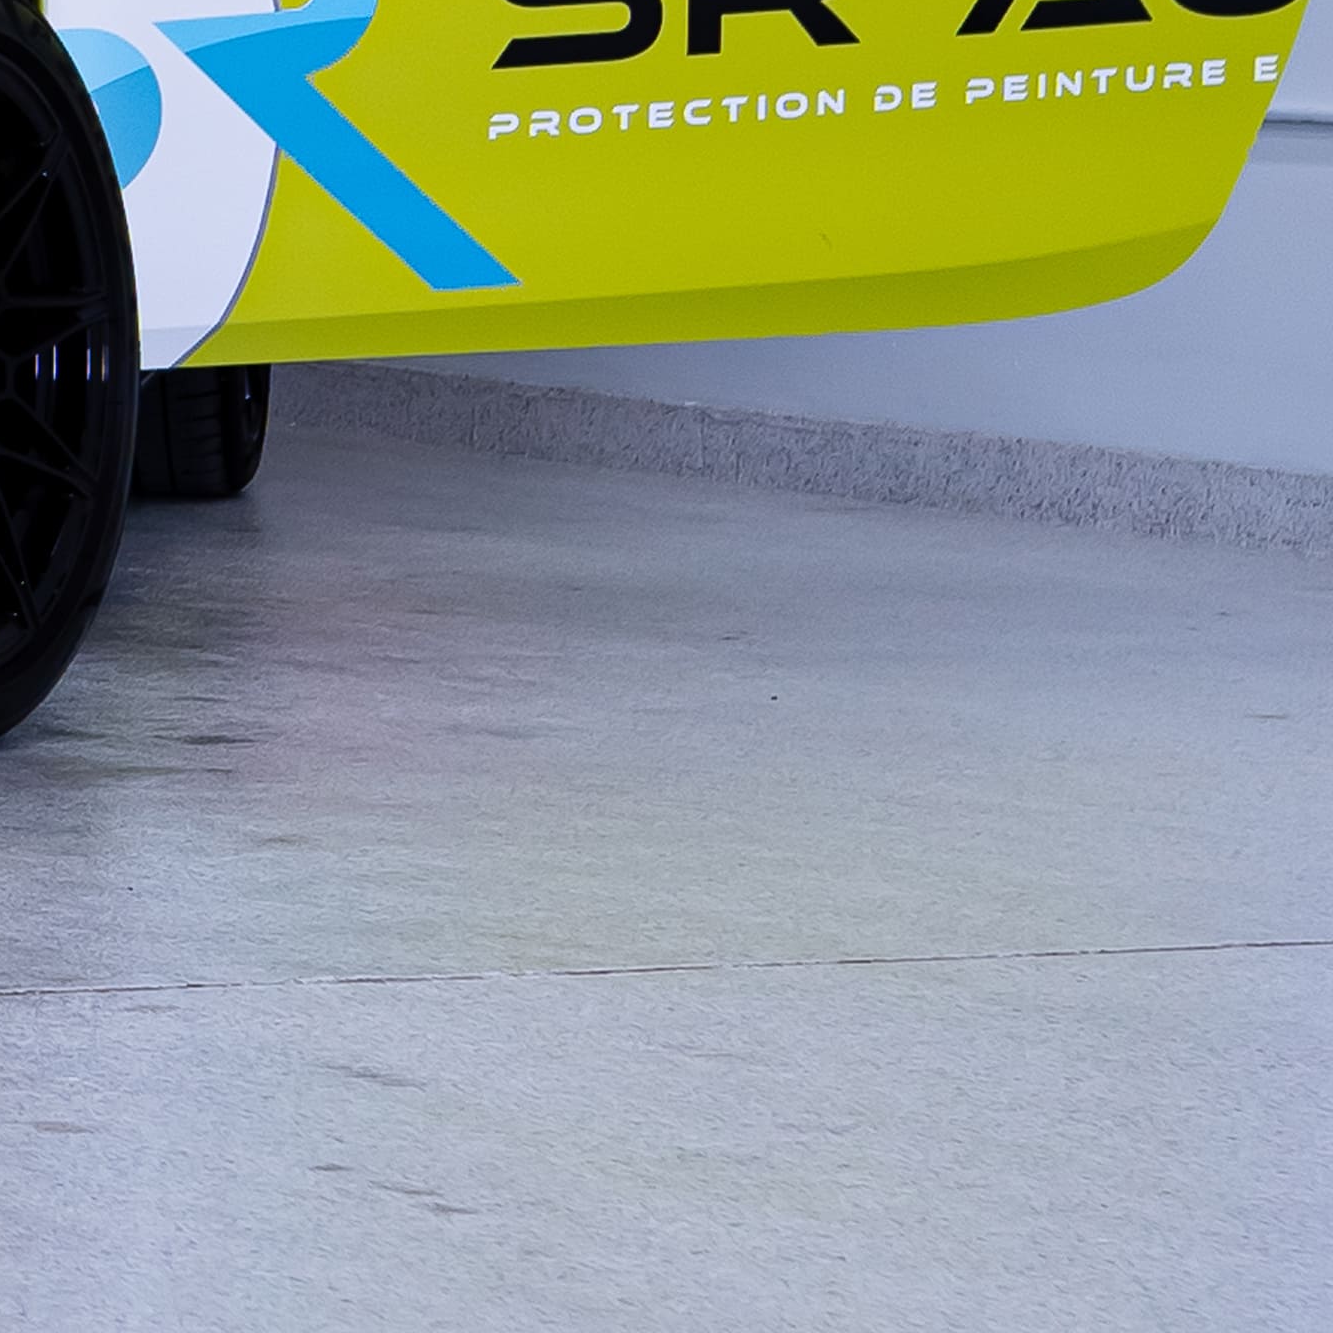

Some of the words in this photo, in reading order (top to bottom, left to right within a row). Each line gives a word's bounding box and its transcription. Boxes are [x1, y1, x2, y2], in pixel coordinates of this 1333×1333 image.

[488, 89, 845, 140] PROTECTION
[874, 81, 937, 112] DE
[965, 59, 1226, 104] PEINTURE
[1254, 55, 1279, 82] E
